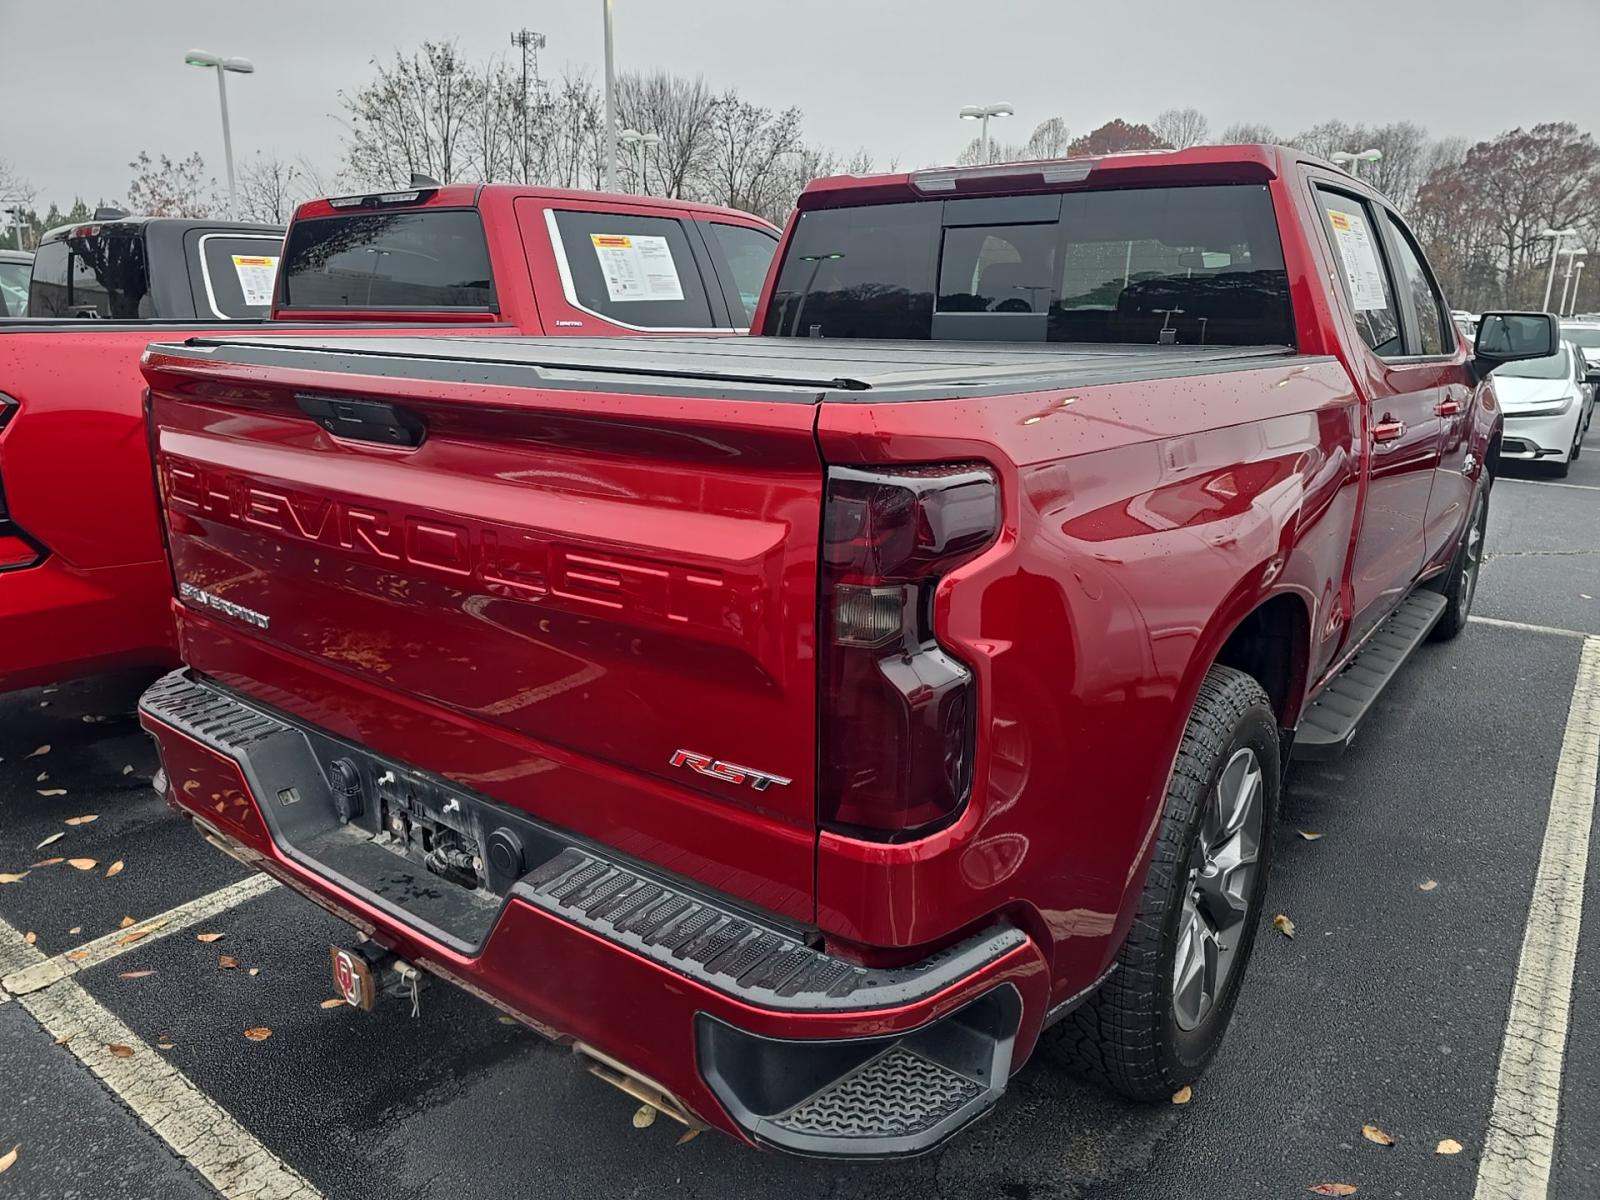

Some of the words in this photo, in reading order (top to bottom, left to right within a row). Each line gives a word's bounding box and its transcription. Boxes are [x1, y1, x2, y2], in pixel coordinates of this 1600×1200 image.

[167, 466, 724, 622] CHEVROLET
[180, 583, 270, 629] SILVERADO
[669, 749, 793, 791] RST
